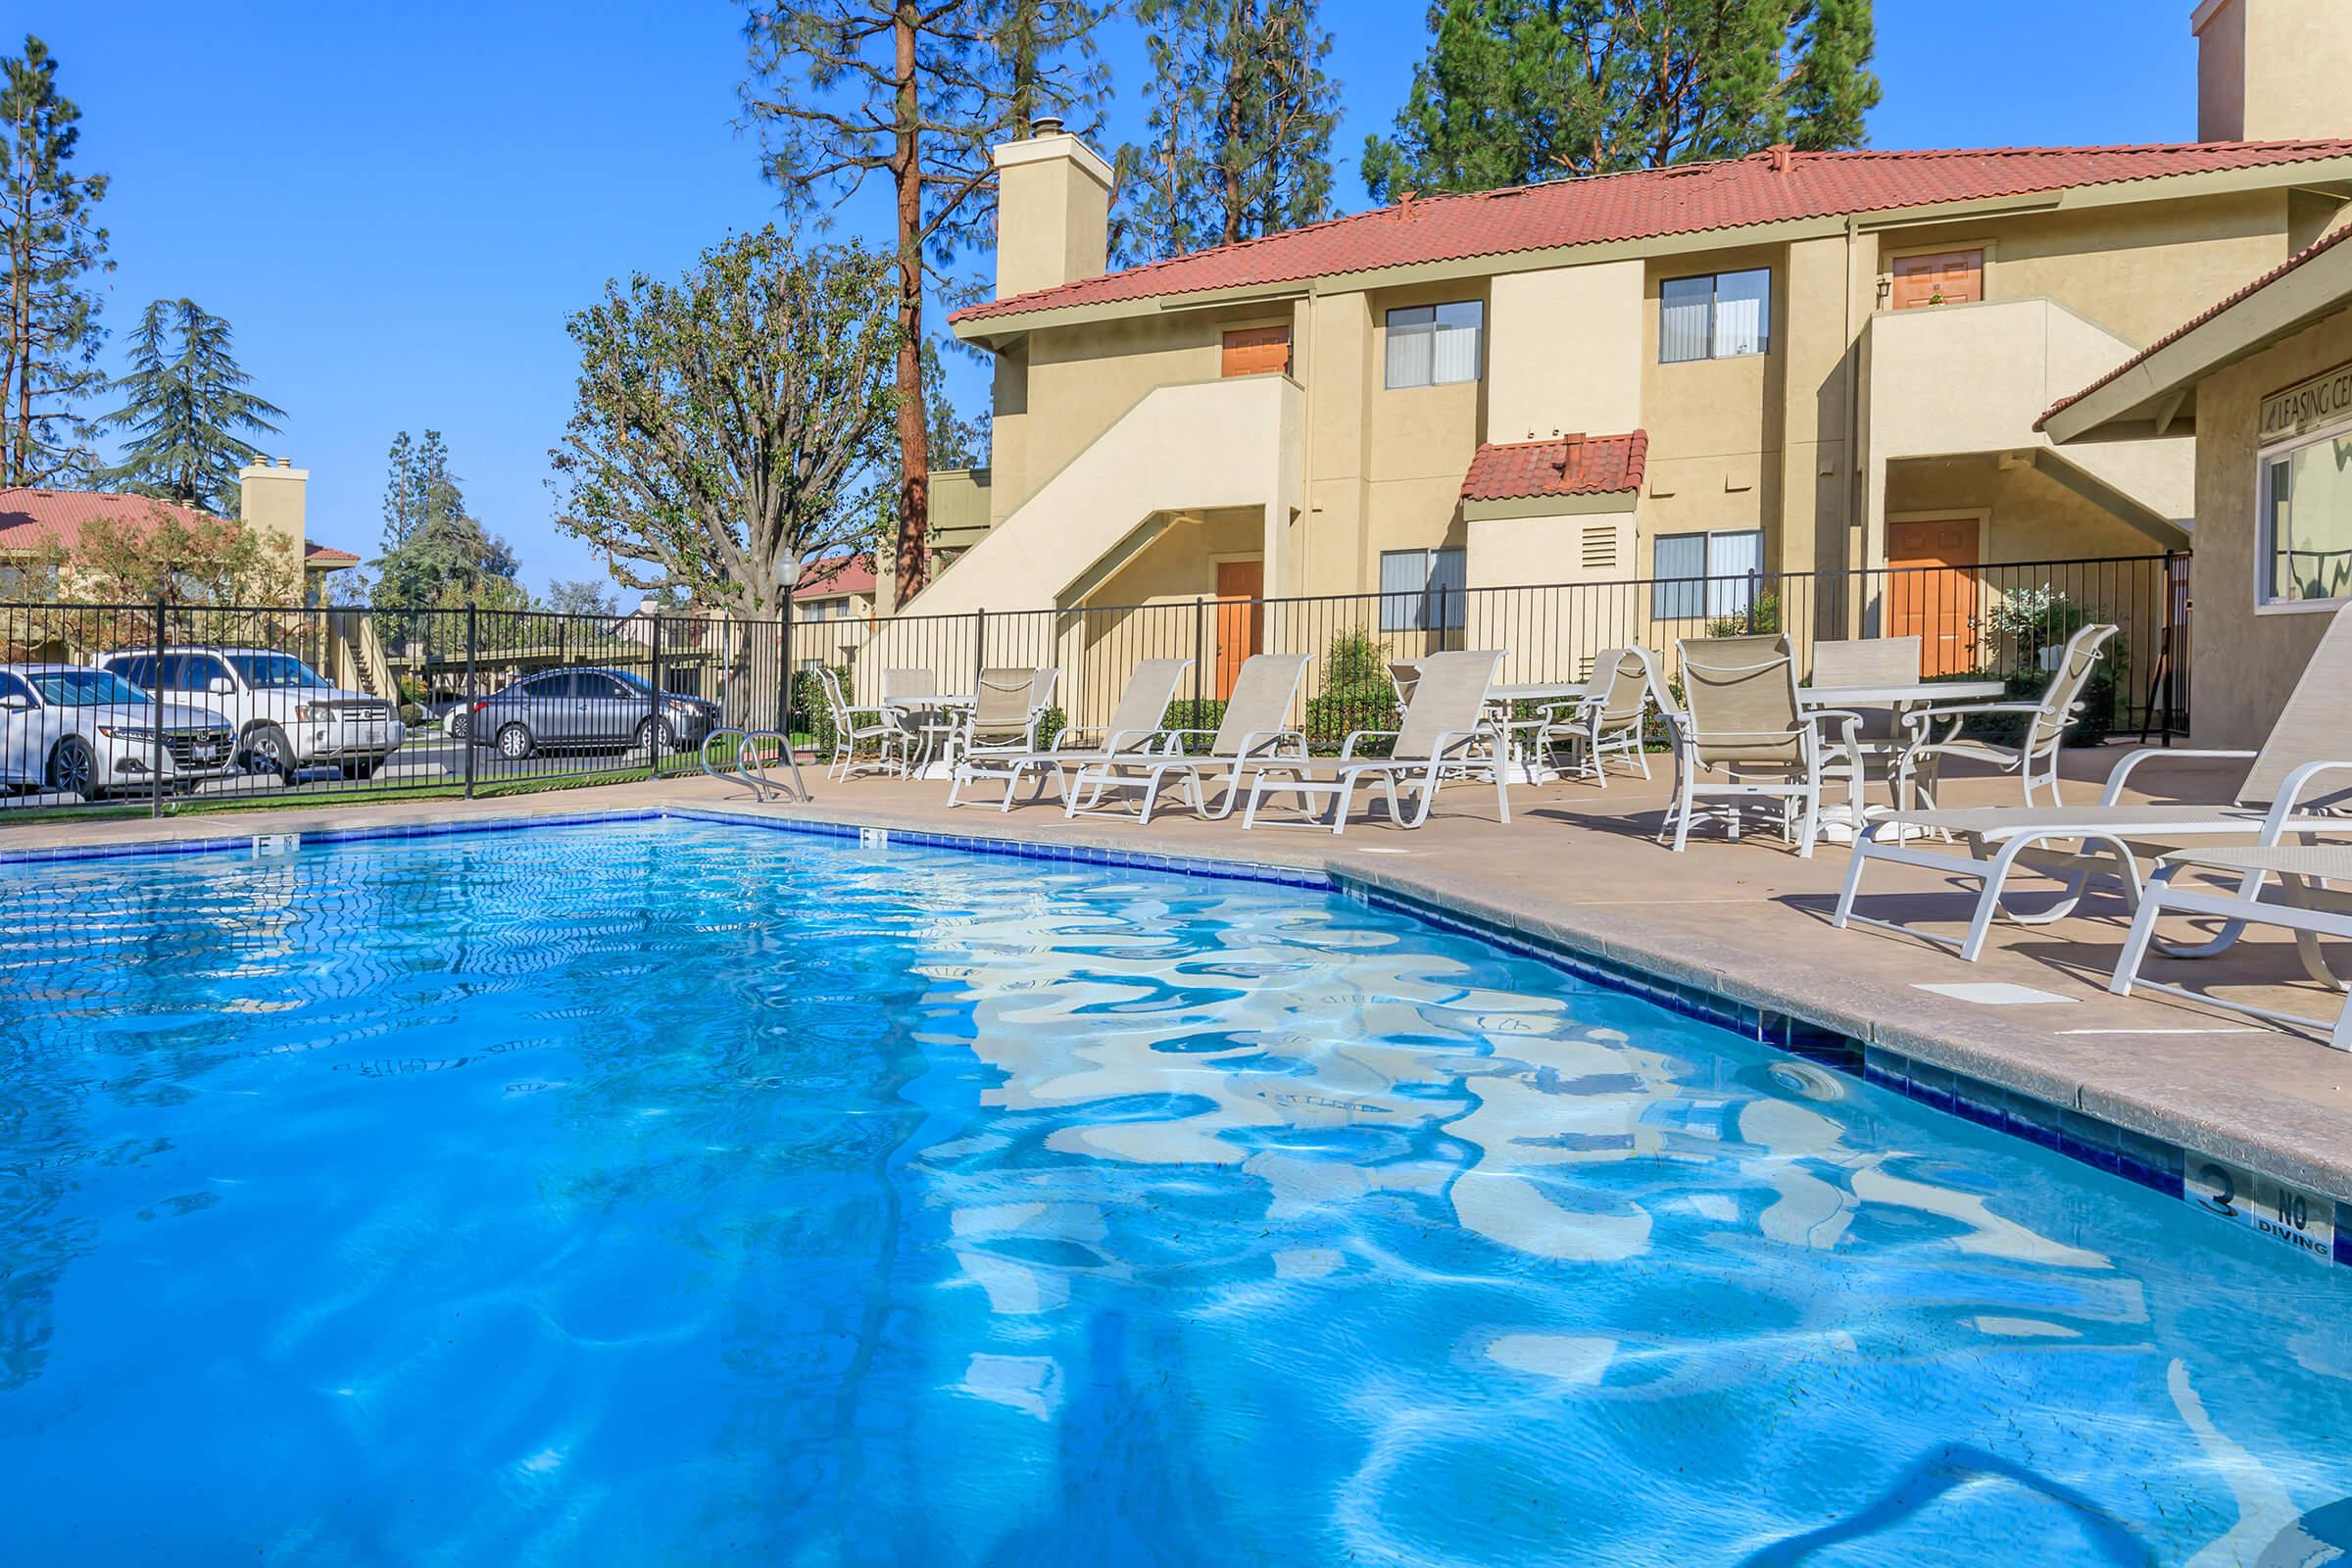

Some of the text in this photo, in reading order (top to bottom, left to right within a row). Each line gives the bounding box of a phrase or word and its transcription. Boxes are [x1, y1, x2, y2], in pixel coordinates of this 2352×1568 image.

[2278, 382, 2328, 429] LEASING
[2197, 1163, 2239, 1217] 3
[2278, 1189, 2308, 1231] NO
[2259, 1219, 2329, 1255] DIVING
